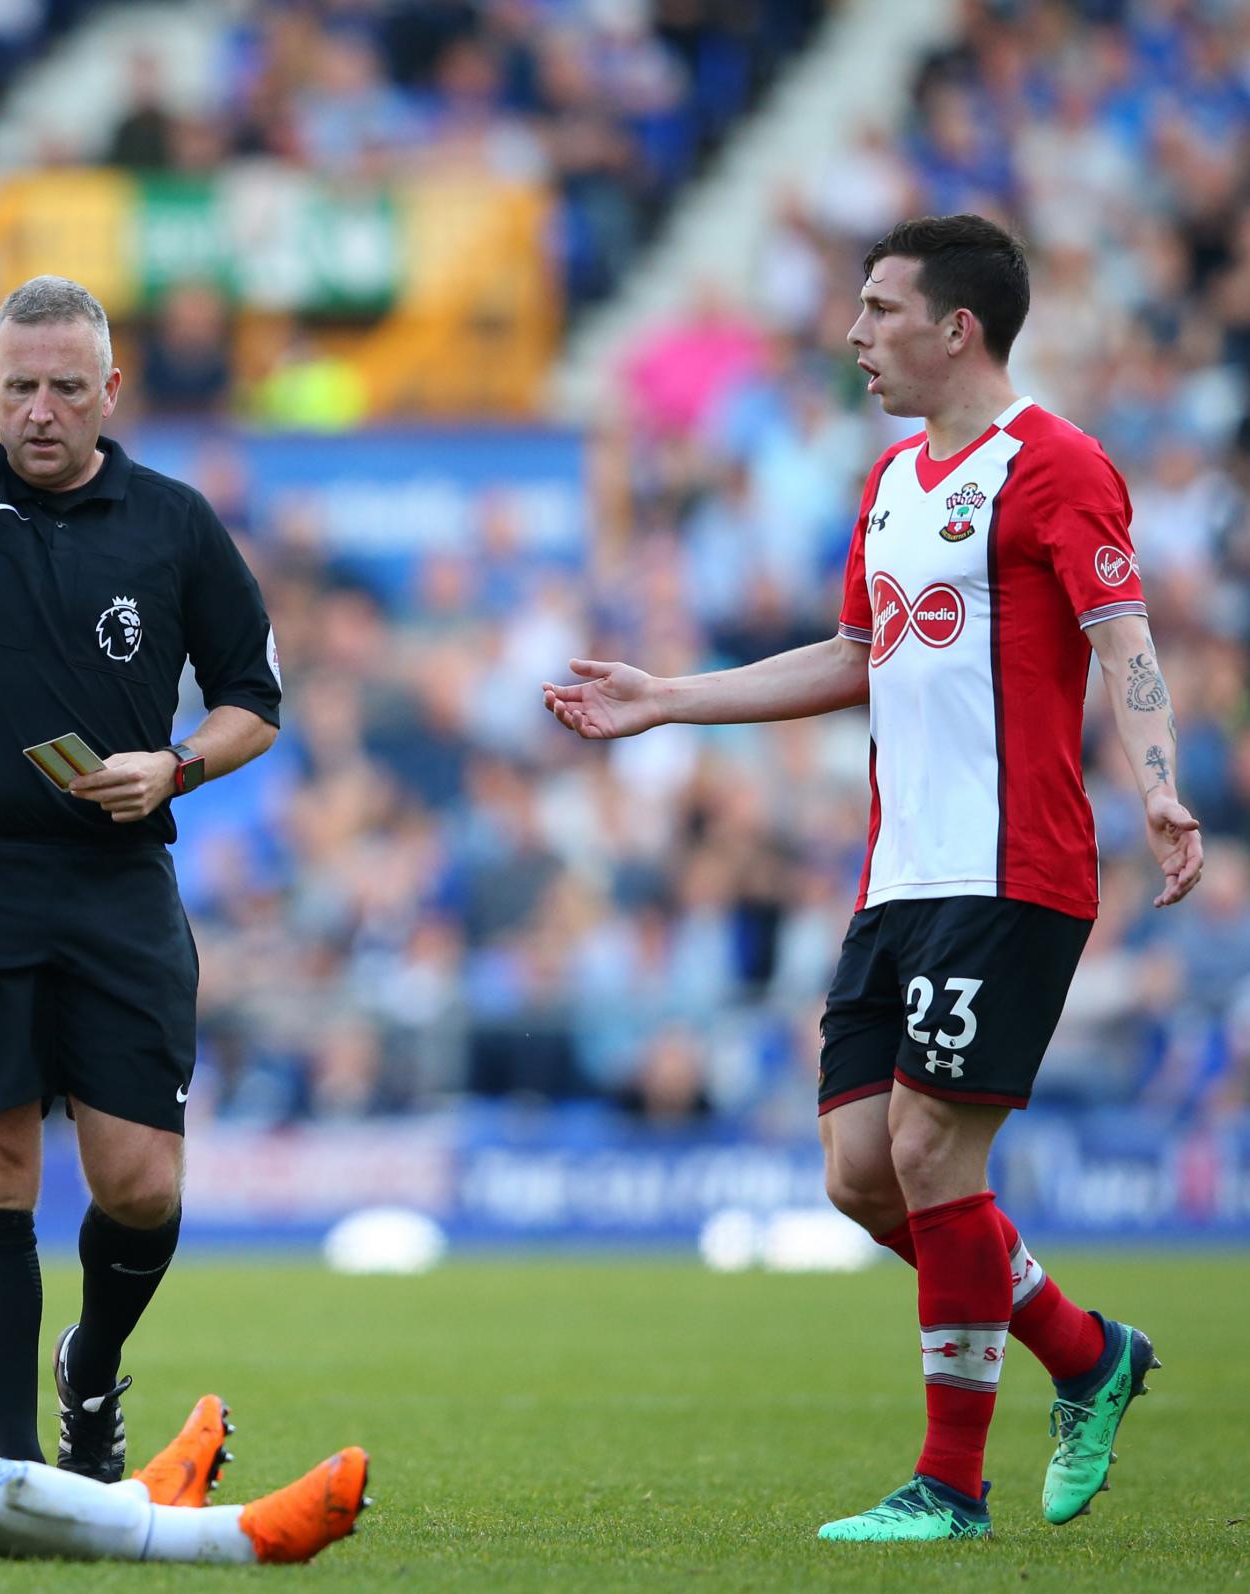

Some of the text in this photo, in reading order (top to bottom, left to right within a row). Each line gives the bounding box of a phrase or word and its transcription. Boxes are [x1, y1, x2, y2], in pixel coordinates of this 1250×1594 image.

[1100, 553, 1126, 578] Virgin
[916, 607, 956, 621] media
[905, 975, 985, 1050] 23
